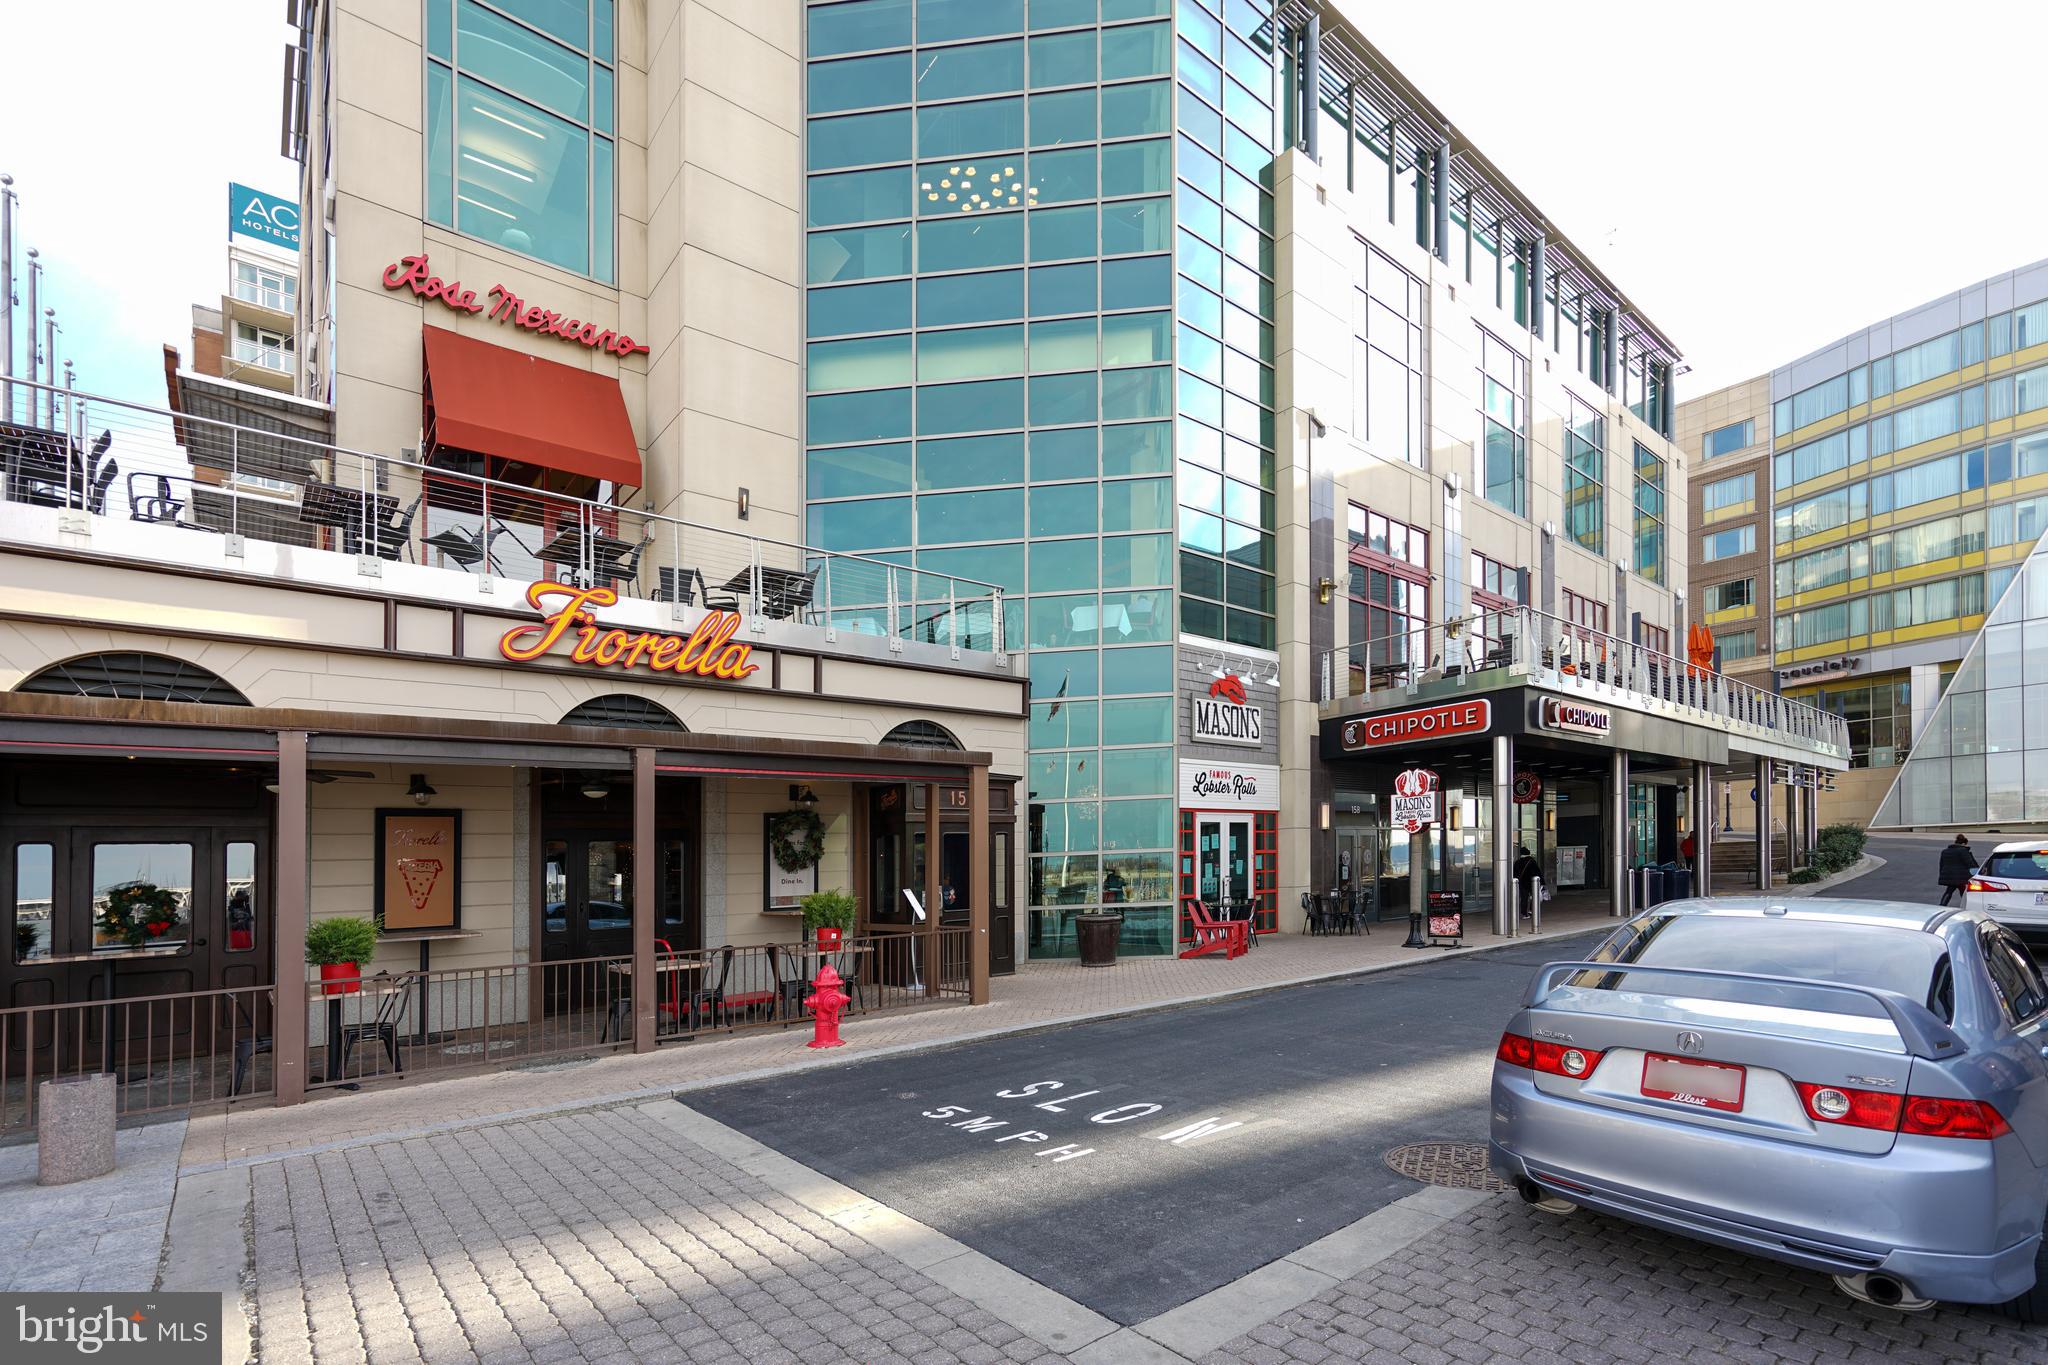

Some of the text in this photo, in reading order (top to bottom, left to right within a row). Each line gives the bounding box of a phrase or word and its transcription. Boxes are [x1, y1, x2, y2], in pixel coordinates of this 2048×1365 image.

[243, 198, 298, 230] AC
[242, 219, 299, 242] HOTELS
[383, 254, 650, 357] Rosa Mexicano
[500, 579, 760, 680] Fiorella
[1196, 701, 1260, 740] MASON'S
[1368, 706, 1478, 739] CHIPOTLE
[1193, 772, 1257, 800] Lobster Rolls
[1209, 769, 1231, 780] FAMOUS
[1351, 805, 1360, 814] 158
[1395, 797, 1432, 811] MASON'S
[1536, 1029, 1575, 1042] ACURA
[1846, 1074, 1897, 1088] TSX
[1670, 1093, 1708, 1106] illest
